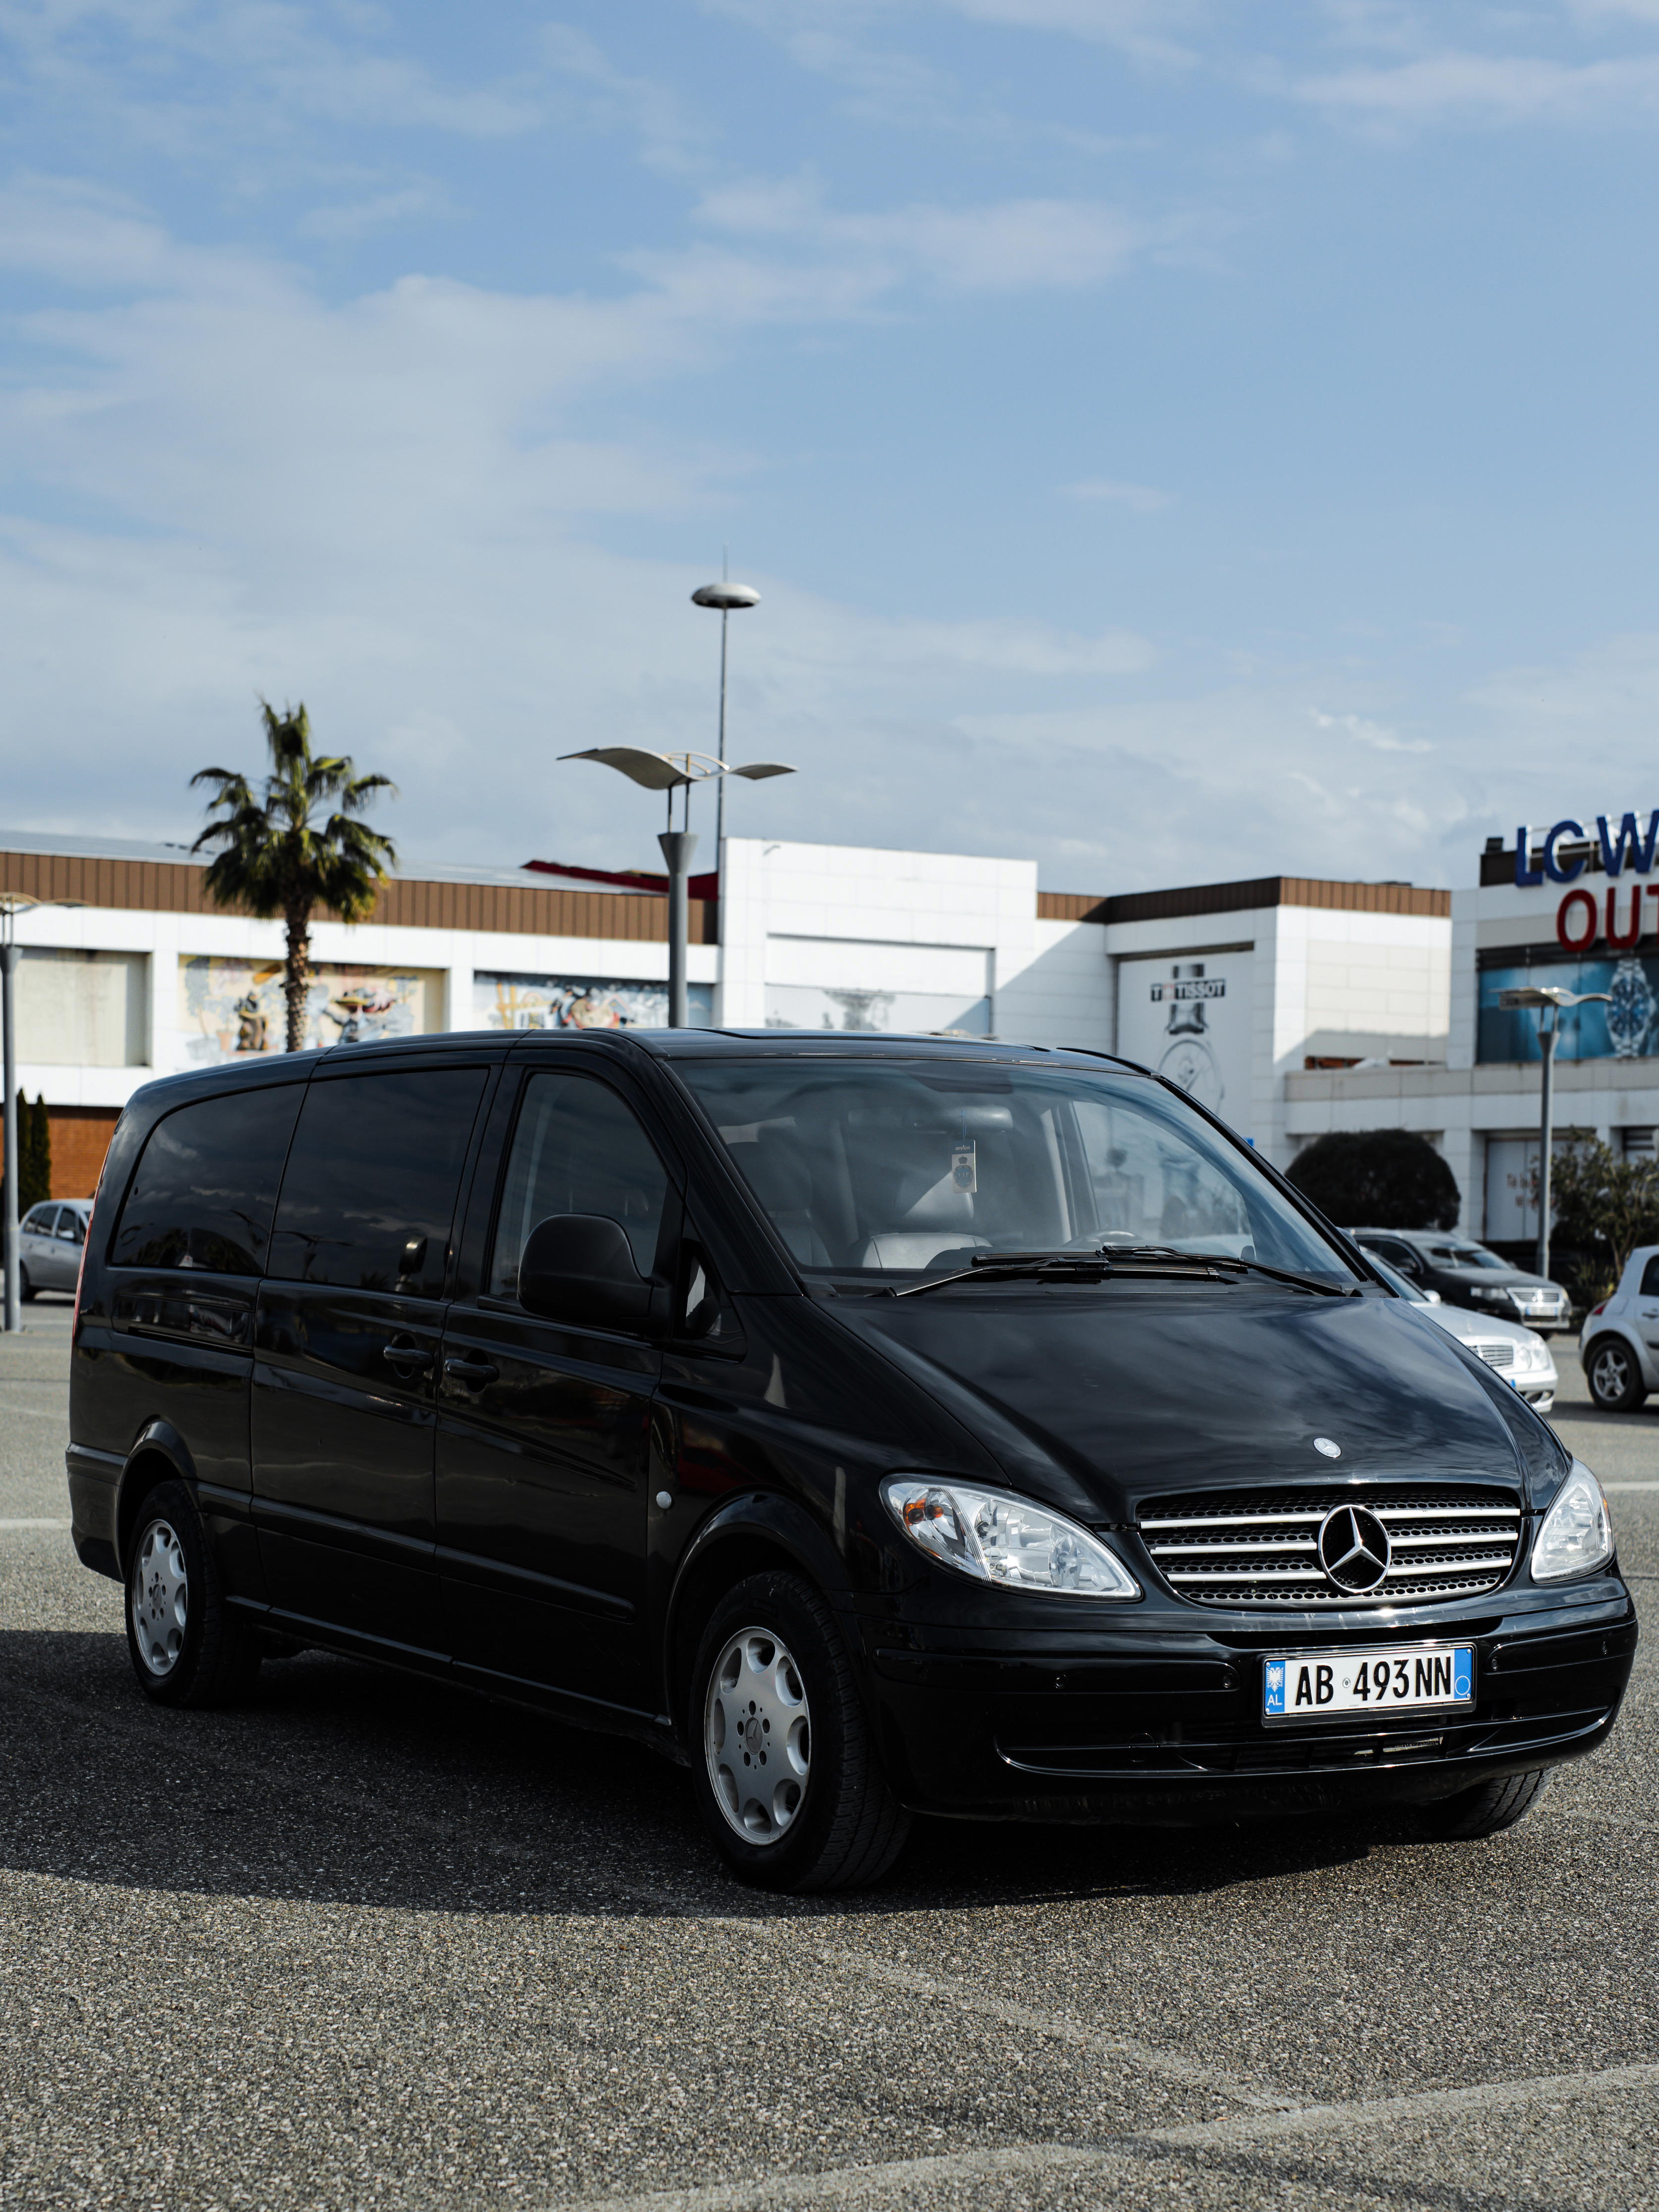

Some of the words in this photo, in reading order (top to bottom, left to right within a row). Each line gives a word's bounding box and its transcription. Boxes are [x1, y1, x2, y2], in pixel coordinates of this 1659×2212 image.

[1176, 980, 1224, 999] TISSOT
[1295, 1665, 1334, 1706] AB
[1353, 1656, 1451, 1701] 493NN
[1267, 1694, 1283, 1706] AL
